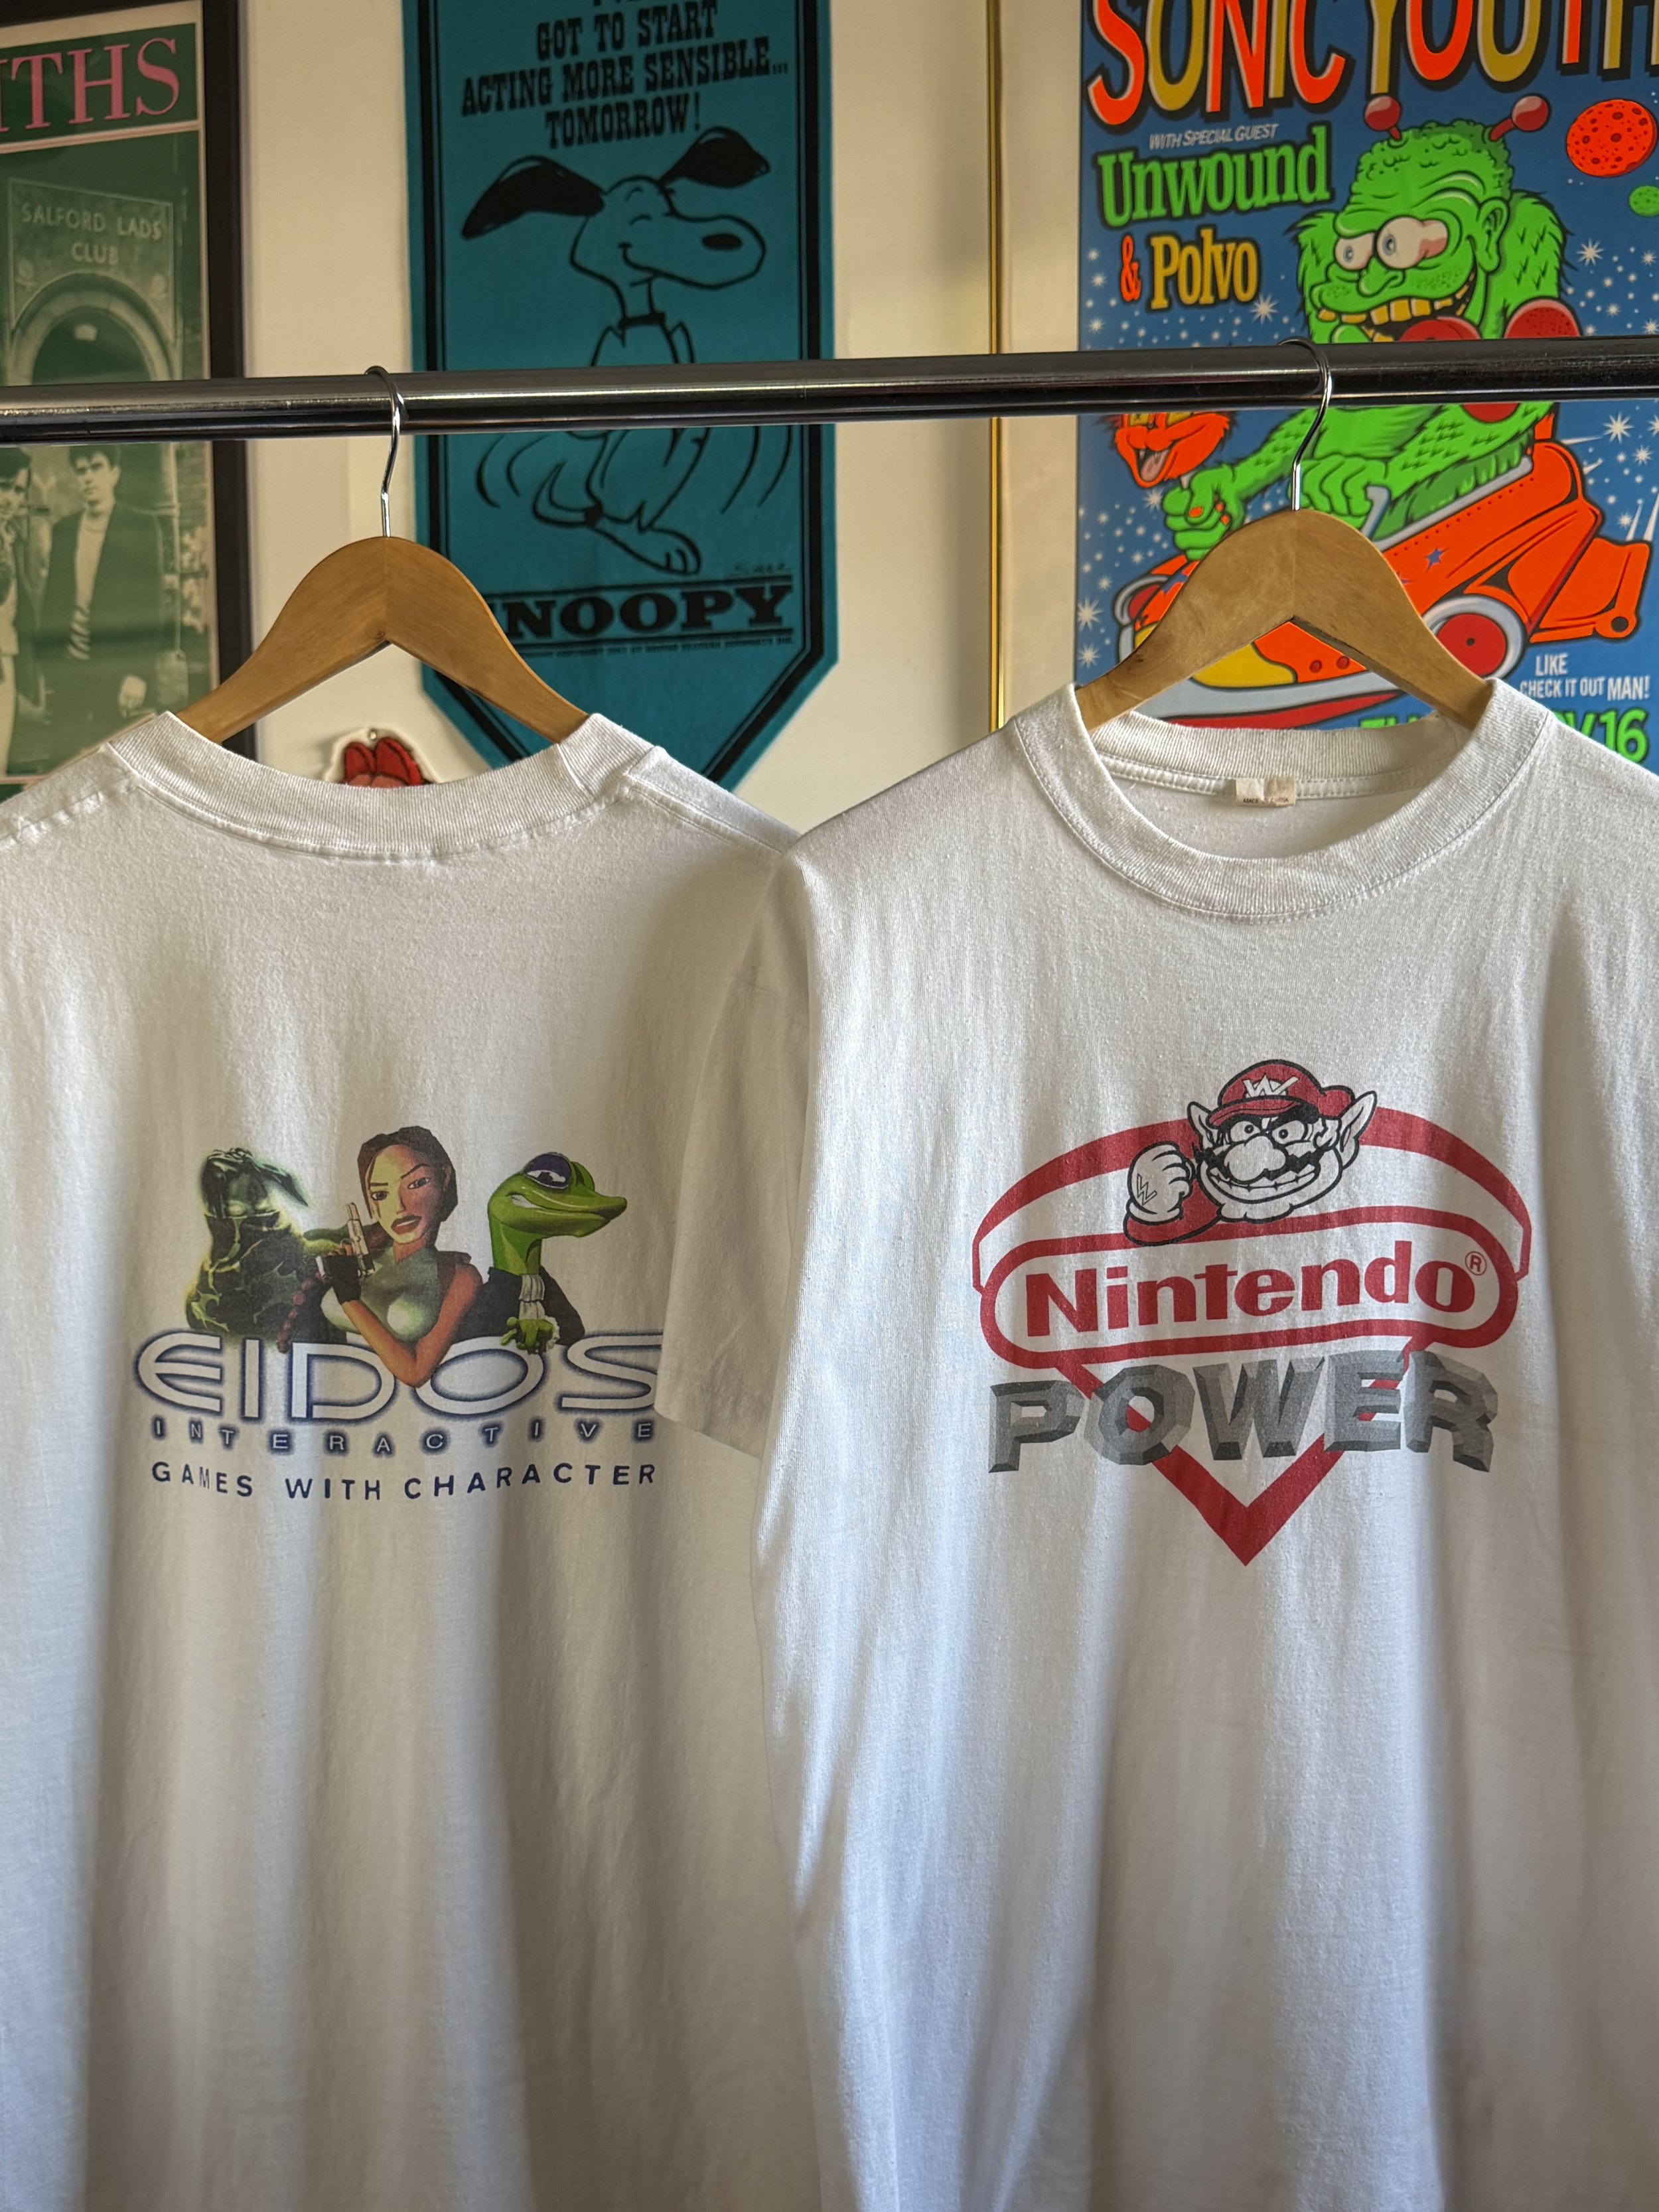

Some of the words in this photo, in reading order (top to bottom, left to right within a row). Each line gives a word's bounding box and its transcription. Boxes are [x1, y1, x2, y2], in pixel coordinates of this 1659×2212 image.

[537, 17, 583, 62] GOT
[595, 11, 624, 52] TO
[637, 1, 717, 46] START
[0, 38, 180, 132] THS
[461, 68, 551, 116] ACTING
[563, 55, 634, 102] MORE
[1088, 0, 1346, 125] SONIC
[545, 92, 700, 149] TOMORROW!
[1149, 133, 1183, 150] WITH
[1183, 127, 1233, 146] SPECIAL
[1235, 123, 1279, 142] GUEST
[1097, 125, 1331, 228] Unwound
[21, 202, 106, 232] SALFORD
[117, 216, 161, 240] LADS
[70, 241, 119, 265] CLUB
[1120, 235, 1141, 302] &
[1150, 228, 1259, 311] Polvo
[489, 585, 794, 639] NOOPY
[1520, 678, 1563, 699] CHECK
[1565, 677, 1578, 697] IT
[1579, 675, 1606, 697] OUT
[1607, 674, 1651, 702] MAN!
[1535, 652, 1569, 677] LIKE
[1599, 708, 1648, 763] 16
[135, 1329, 664, 1424] EIDOS
[153, 1417, 654, 1454] INTERACTIVE
[988, 1349, 1498, 1474] POWER
[152, 1462, 253, 1497] GAMES
[285, 1478, 380, 1500] WITH
[404, 1462, 655, 1499] CHARACTER
